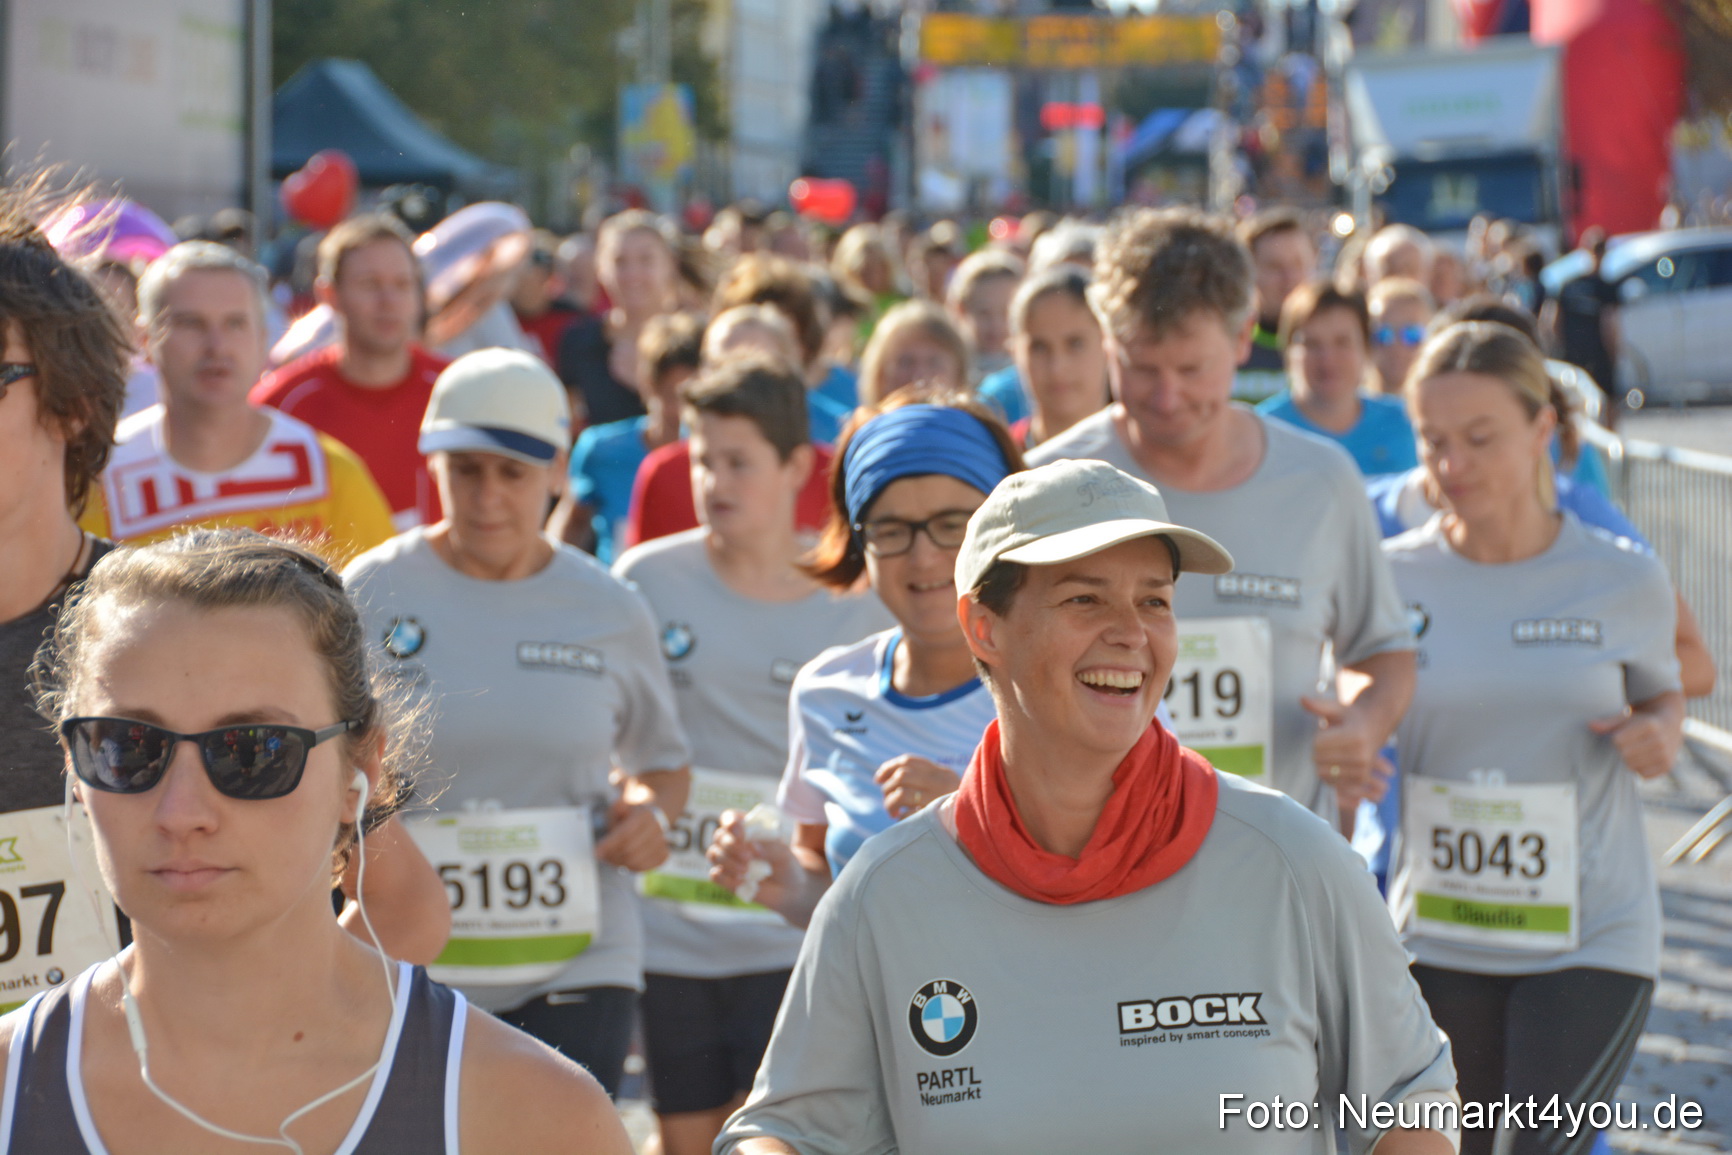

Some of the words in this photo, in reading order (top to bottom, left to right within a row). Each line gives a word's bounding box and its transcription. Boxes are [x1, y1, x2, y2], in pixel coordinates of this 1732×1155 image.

[1431, 826, 1547, 879] 5043
[437, 858, 568, 911] 5193
[912, 981, 972, 1009] BMW
[1118, 993, 1267, 1034] BOCK
[1119, 1033, 1167, 1047] inspired
[1169, 1032, 1184, 1043] by
[1187, 1028, 1221, 1041] smart
[1223, 1027, 1272, 1039] concepts
[916, 1066, 982, 1091] PARTL
[920, 1087, 982, 1107] Neumarkt
